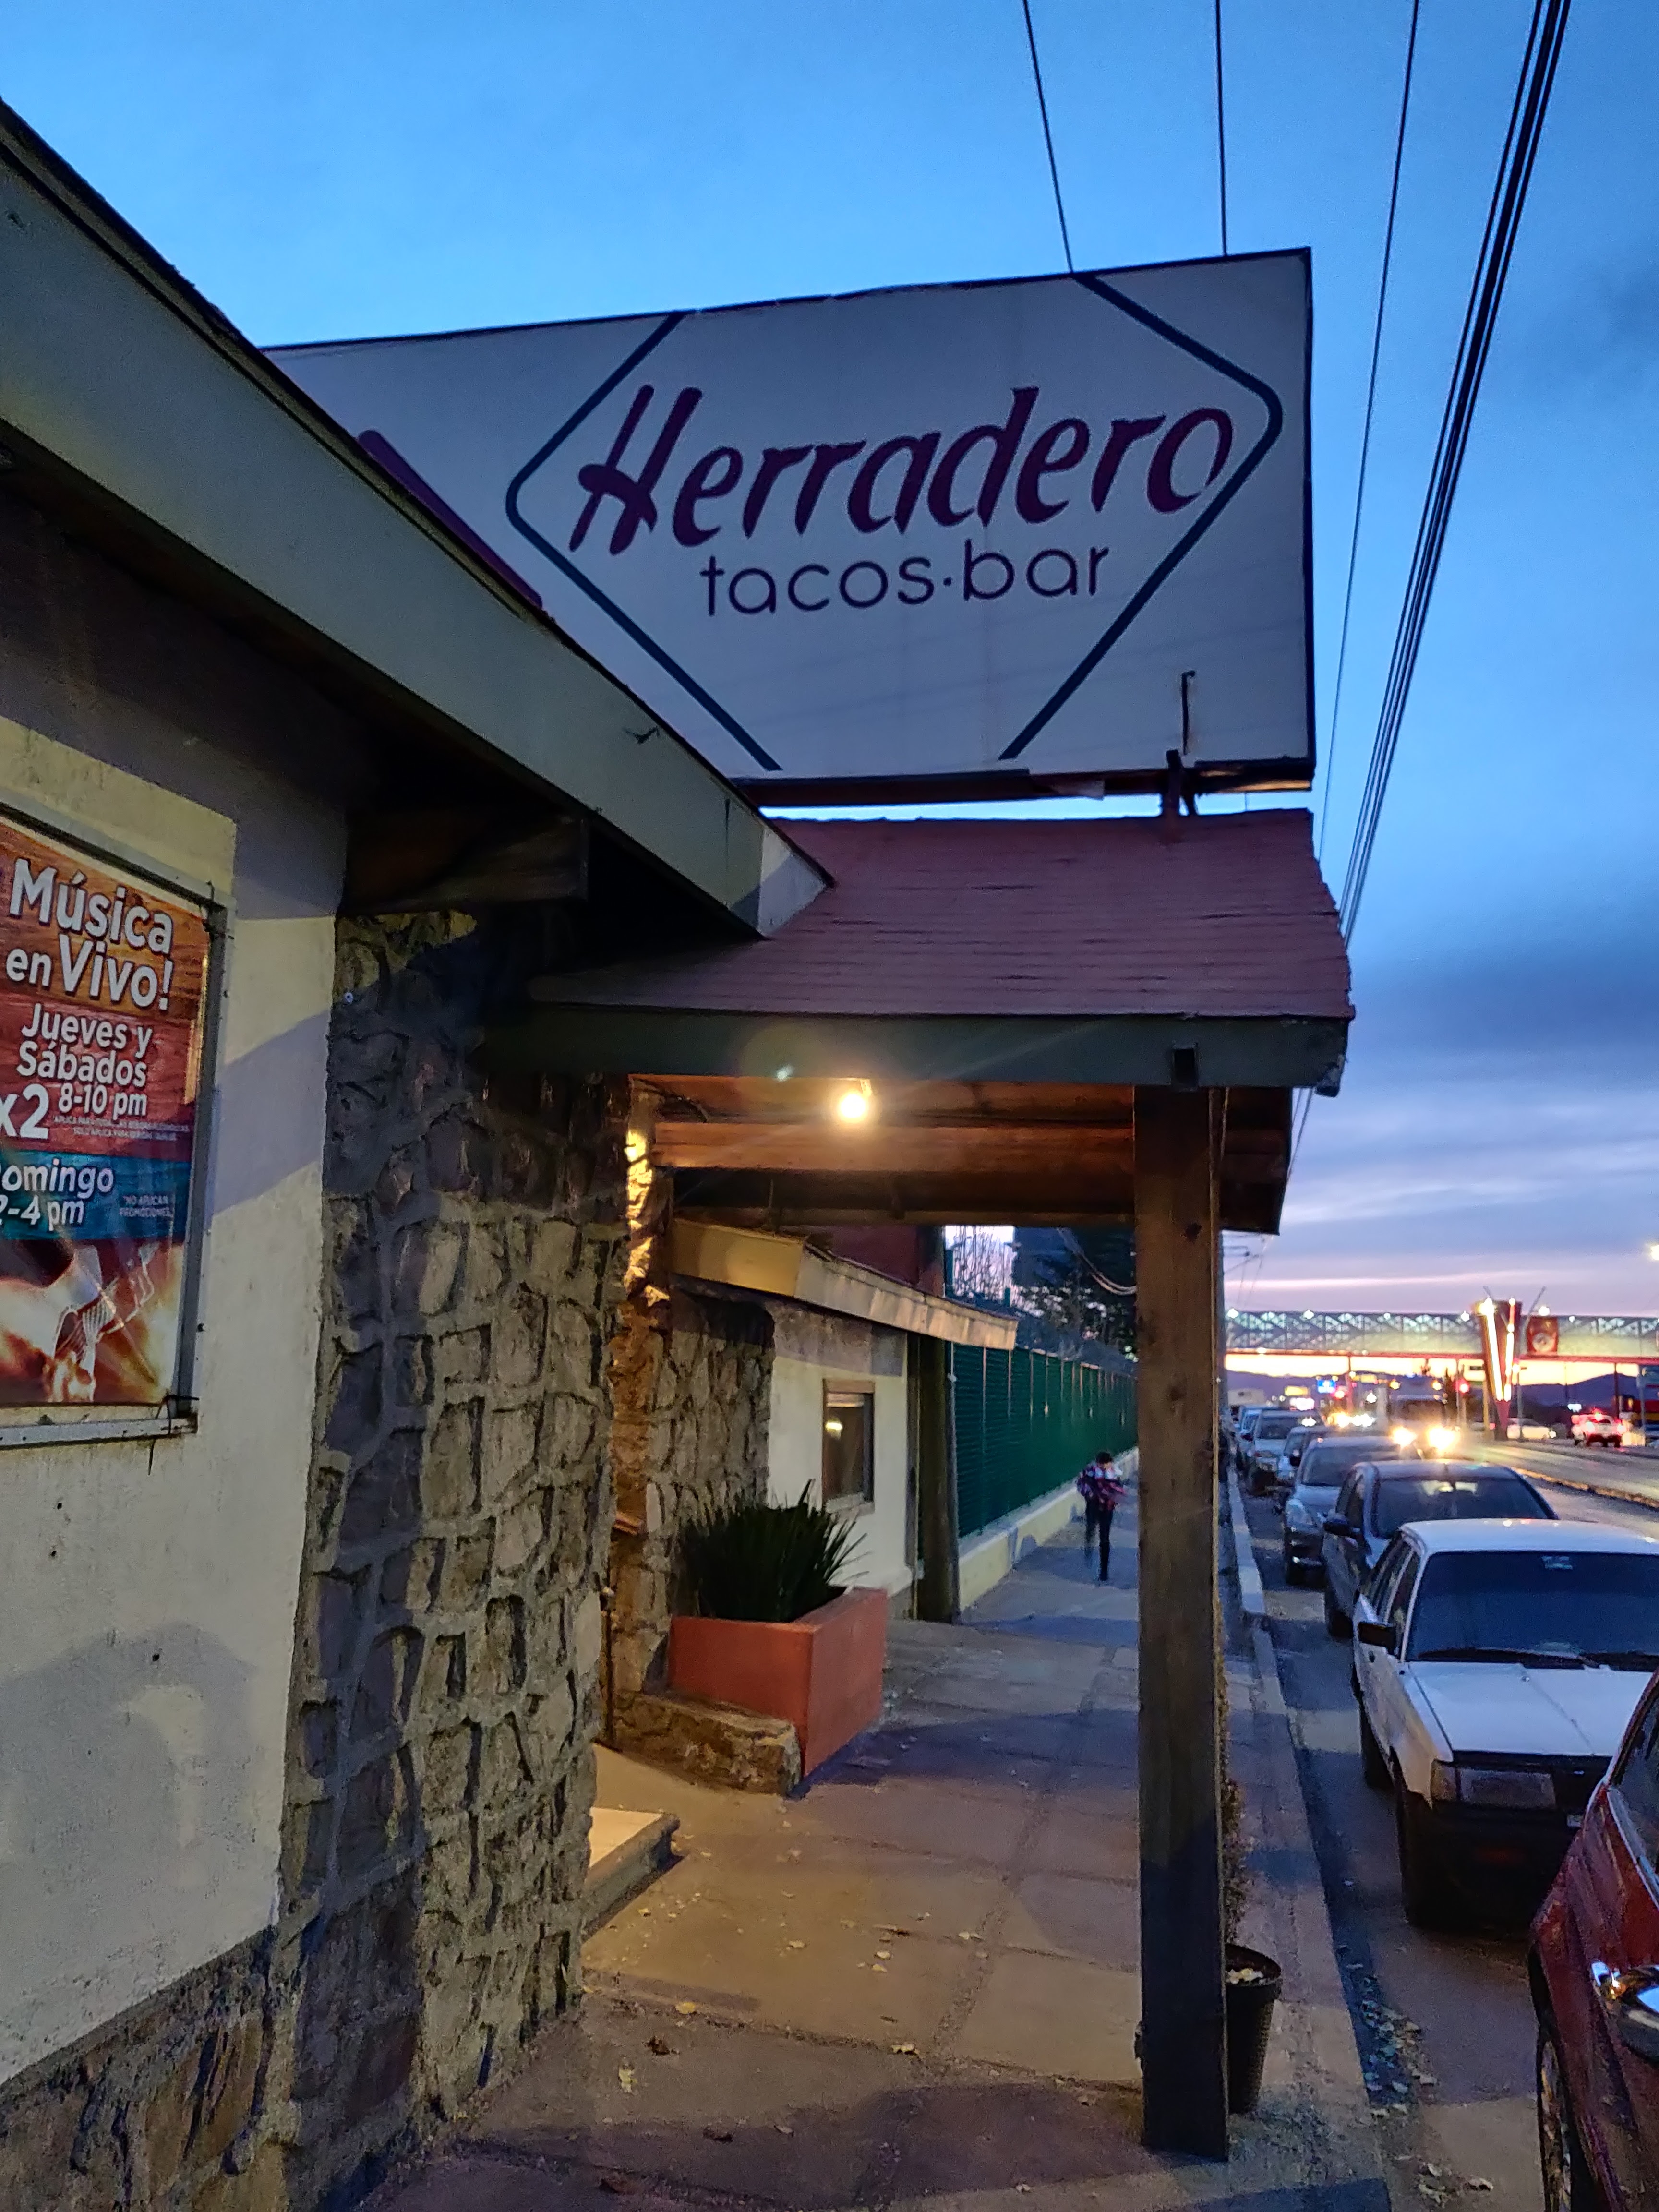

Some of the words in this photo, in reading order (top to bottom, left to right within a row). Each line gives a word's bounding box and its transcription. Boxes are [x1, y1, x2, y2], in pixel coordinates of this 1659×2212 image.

[569, 384, 1234, 555] Herradero
[9, 858, 173, 954] Música
[6, 948, 50, 986] en
[59, 933, 172, 1011] Vivo!
[21, 1003, 128, 1049] Jueves
[135, 1026, 153, 1058] y
[16, 1040, 147, 1088] Sábados
[58, 1082, 108, 1115] 8-10
[112, 1092, 147, 1121] pm
[0, 1158, 114, 1199] omingo
[47, 1200, 84, 1232] pm
